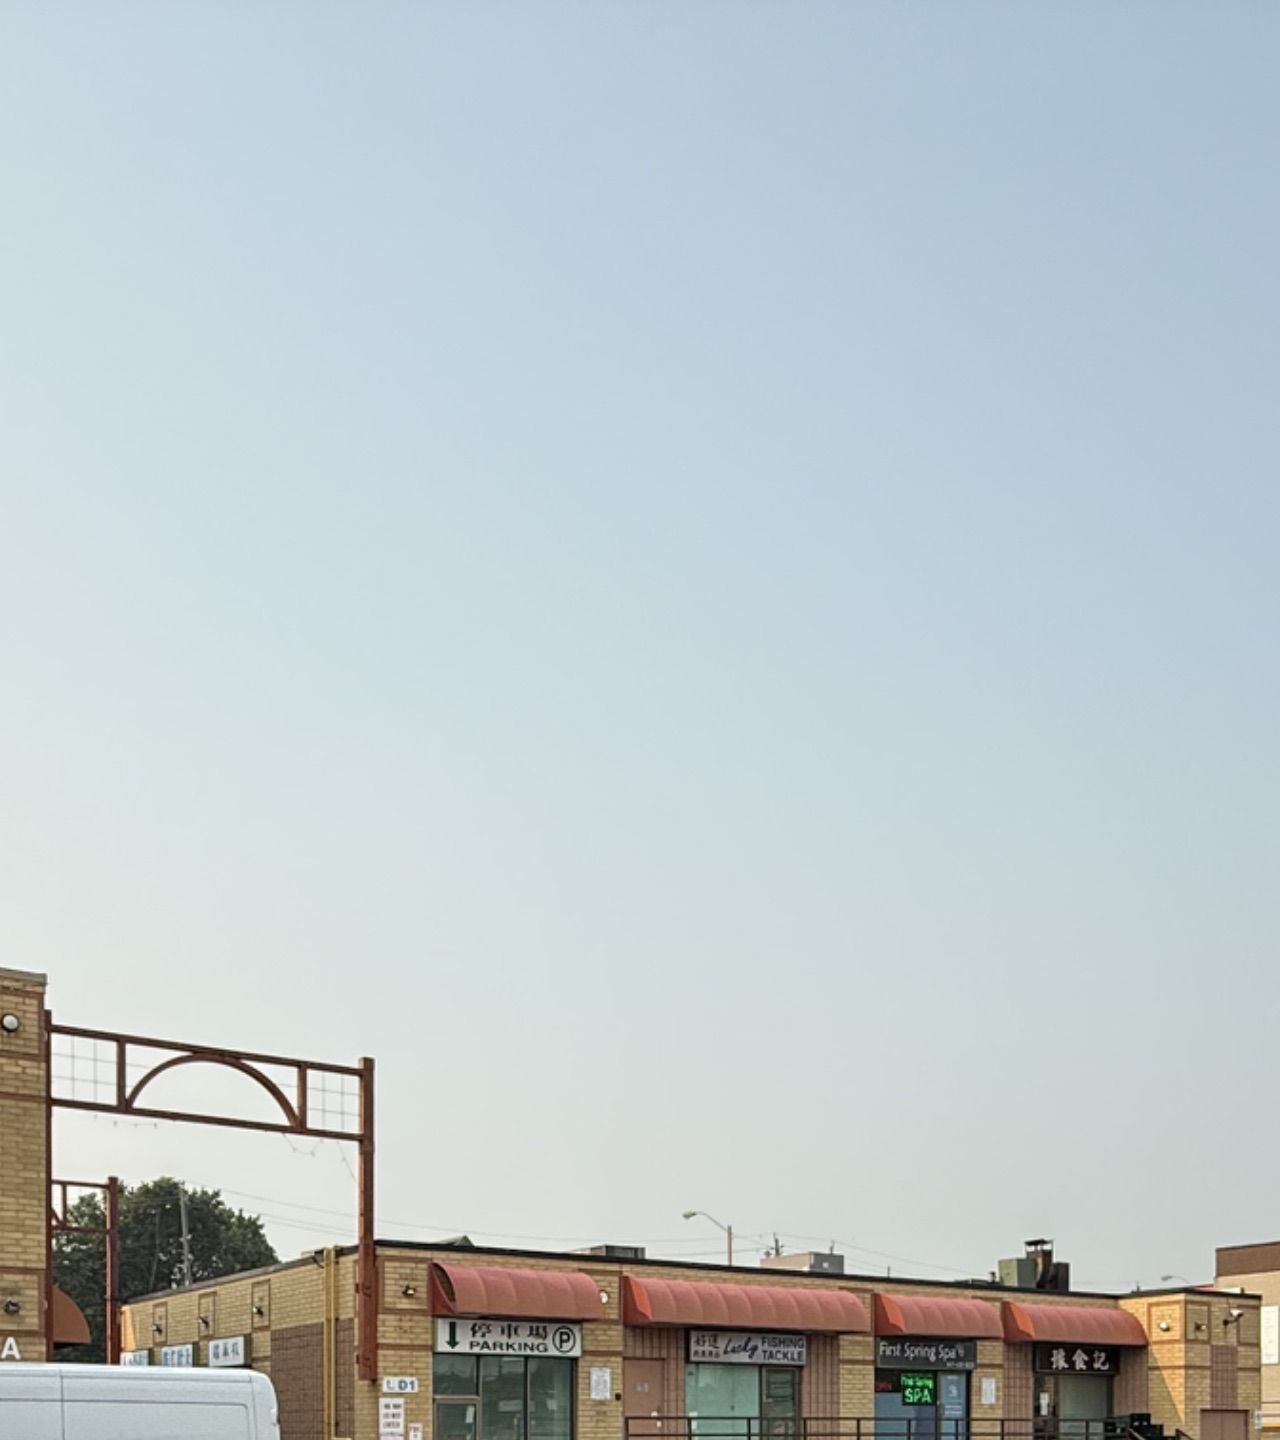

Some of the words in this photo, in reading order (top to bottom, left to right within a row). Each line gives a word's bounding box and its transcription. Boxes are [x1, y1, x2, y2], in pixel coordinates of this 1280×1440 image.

[0, 1336, 22, 1360] A
[470, 1341, 548, 1353] PARKING
[723, 1336, 759, 1360] Lucky
[762, 1336, 805, 1348] FISHING
[762, 1350, 801, 1361] TACKLE
[880, 1341, 901, 1357] First
[904, 1342, 936, 1362] Spring
[939, 1343, 956, 1361] Spa
[904, 1388, 932, 1403] SPA
